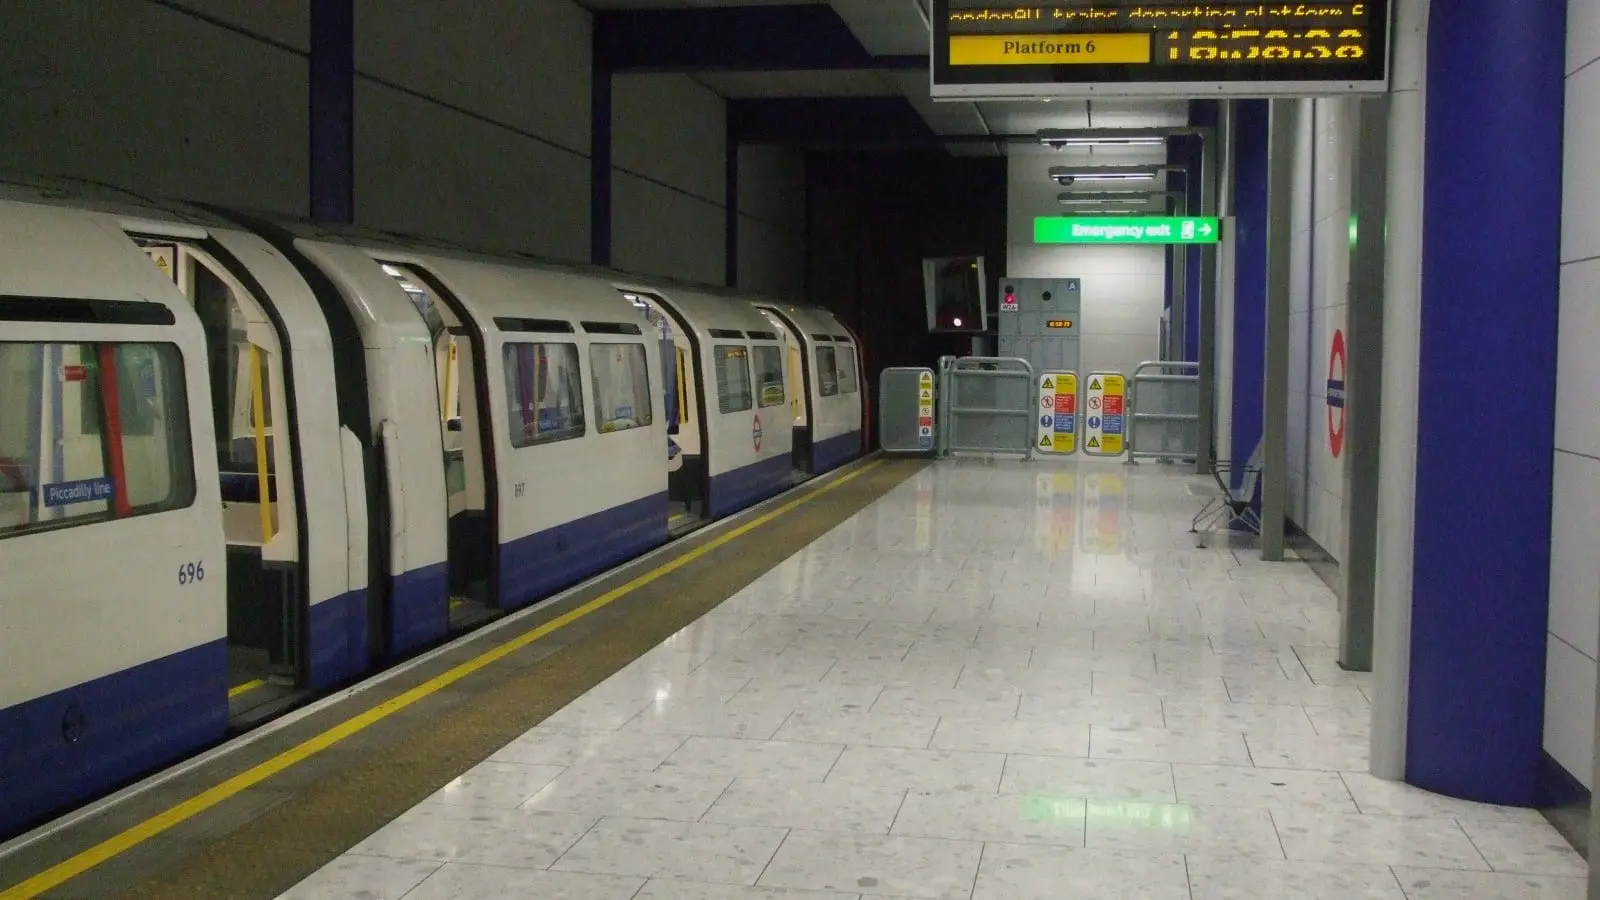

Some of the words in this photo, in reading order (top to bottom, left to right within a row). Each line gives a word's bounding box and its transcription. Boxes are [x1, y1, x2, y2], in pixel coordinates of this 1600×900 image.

[1003, 40, 1081, 54] Platform
[1085, 40, 1096, 54] 6
[1072, 224, 1143, 239] Emergency
[1146, 224, 1171, 236] exit
[1068, 282, 1076, 290] A
[49, 482, 92, 500] Piccadilly
[94, 482, 112, 495] line
[178, 560, 204, 585] 696
